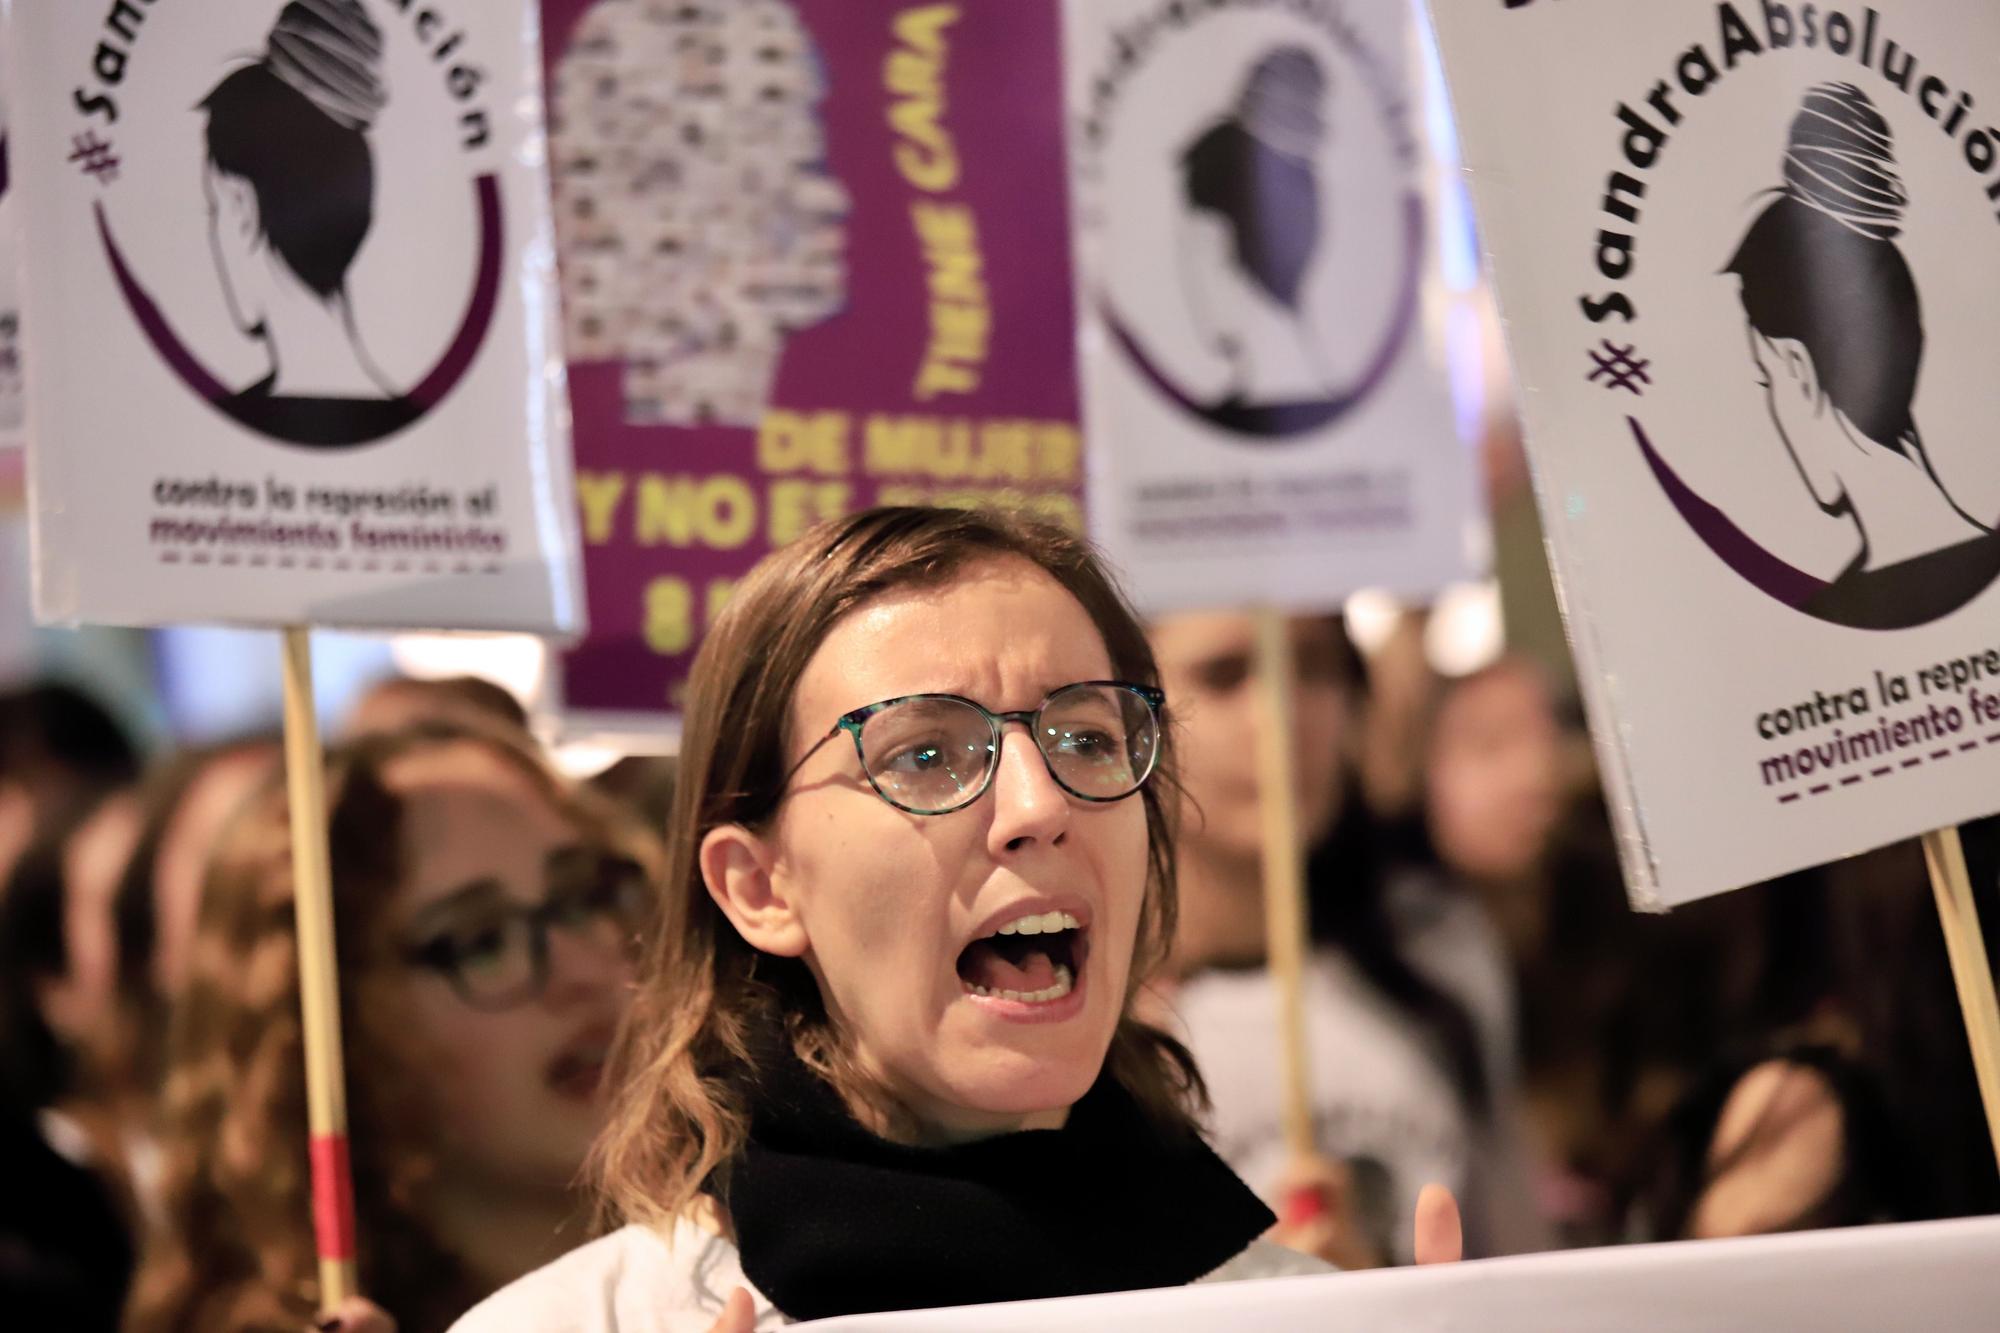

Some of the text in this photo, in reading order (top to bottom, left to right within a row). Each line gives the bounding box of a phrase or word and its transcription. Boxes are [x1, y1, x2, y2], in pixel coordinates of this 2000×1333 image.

[68, 0, 489, 187] #San ción
[885, 3, 962, 192] CARA
[758, 411, 850, 475] DE
[576, 471, 626, 546] Y
[634, 473, 757, 549] NO
[1757, 690, 1870, 740] contra
[1873, 669, 1910, 706] la
[1760, 703, 1963, 786] movimiento
